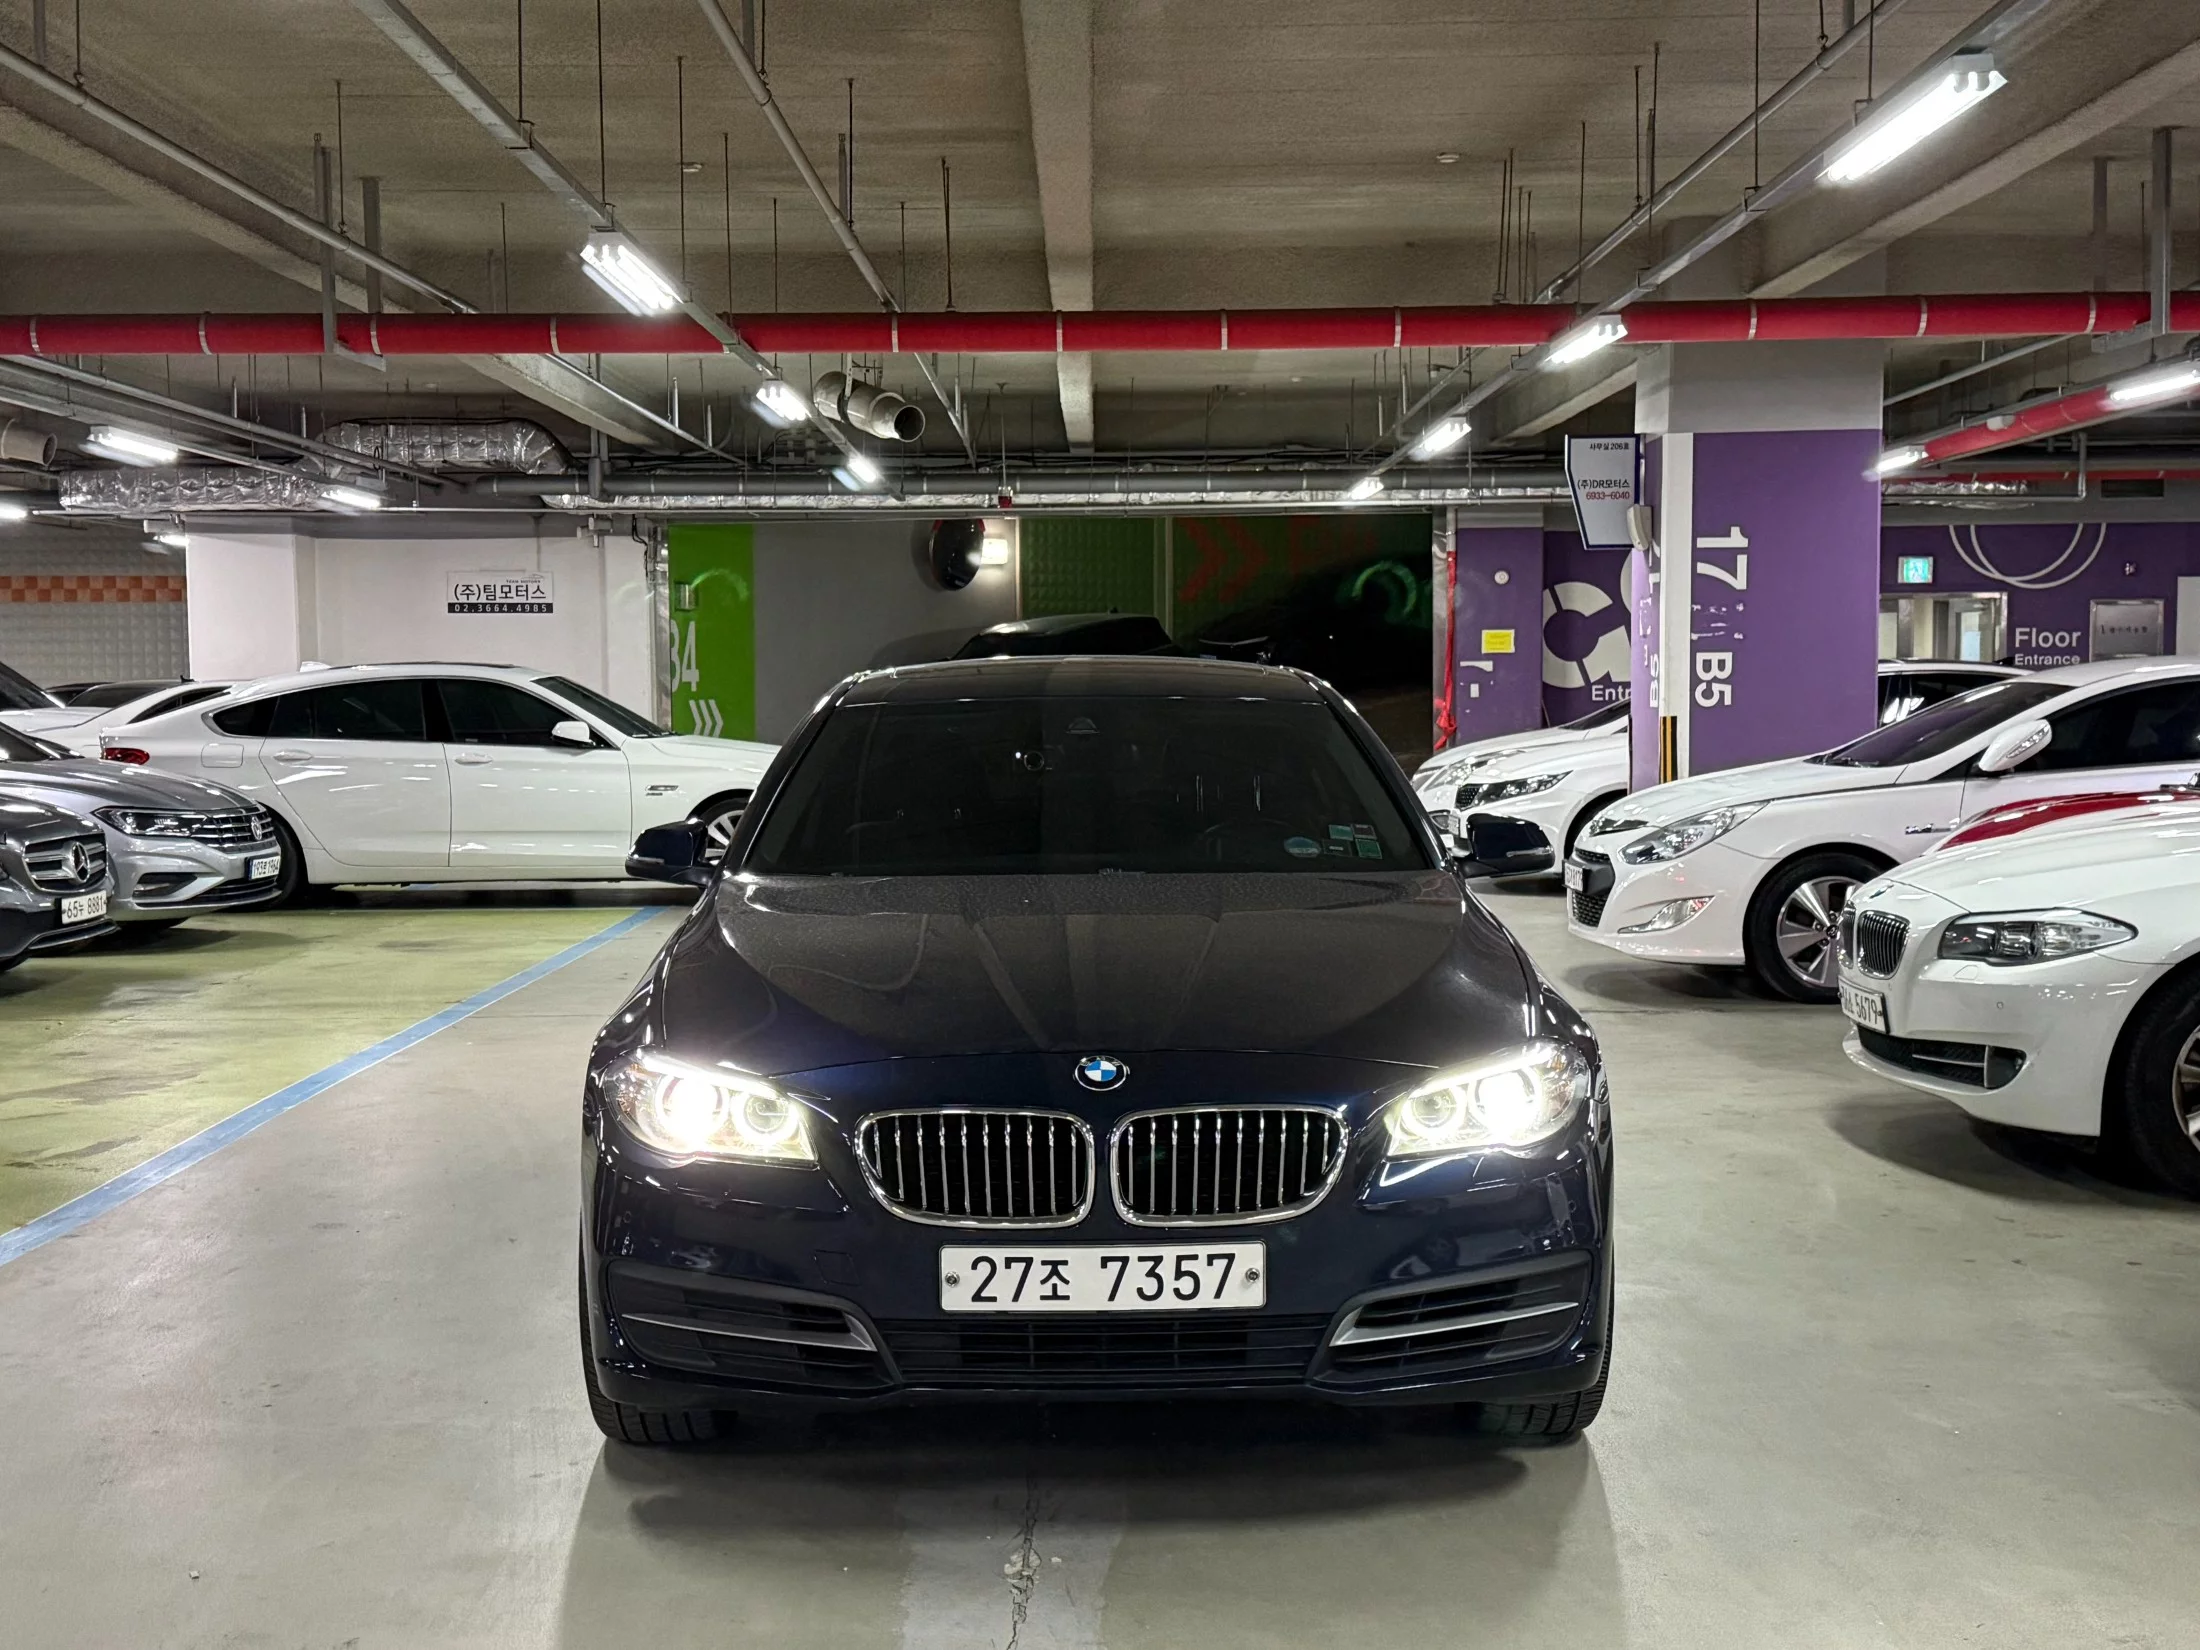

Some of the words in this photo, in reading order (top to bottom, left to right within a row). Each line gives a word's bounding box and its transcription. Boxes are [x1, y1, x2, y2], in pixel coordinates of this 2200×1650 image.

[1577, 479, 1630, 489] (주)DR모터스
[1696, 526, 1749, 591] 17
[454, 583, 547, 601] (주)팀모터스
[454, 603, 547, 612] 02.3664.4985
[2015, 627, 2082, 648] Floor
[2014, 653, 2081, 666] Entrance
[1694, 651, 1733, 708] B5
[1855, 992, 1878, 1025] 5679
[970, 1255, 1071, 1303] 27조
[1099, 1252, 1237, 1302] 7357
